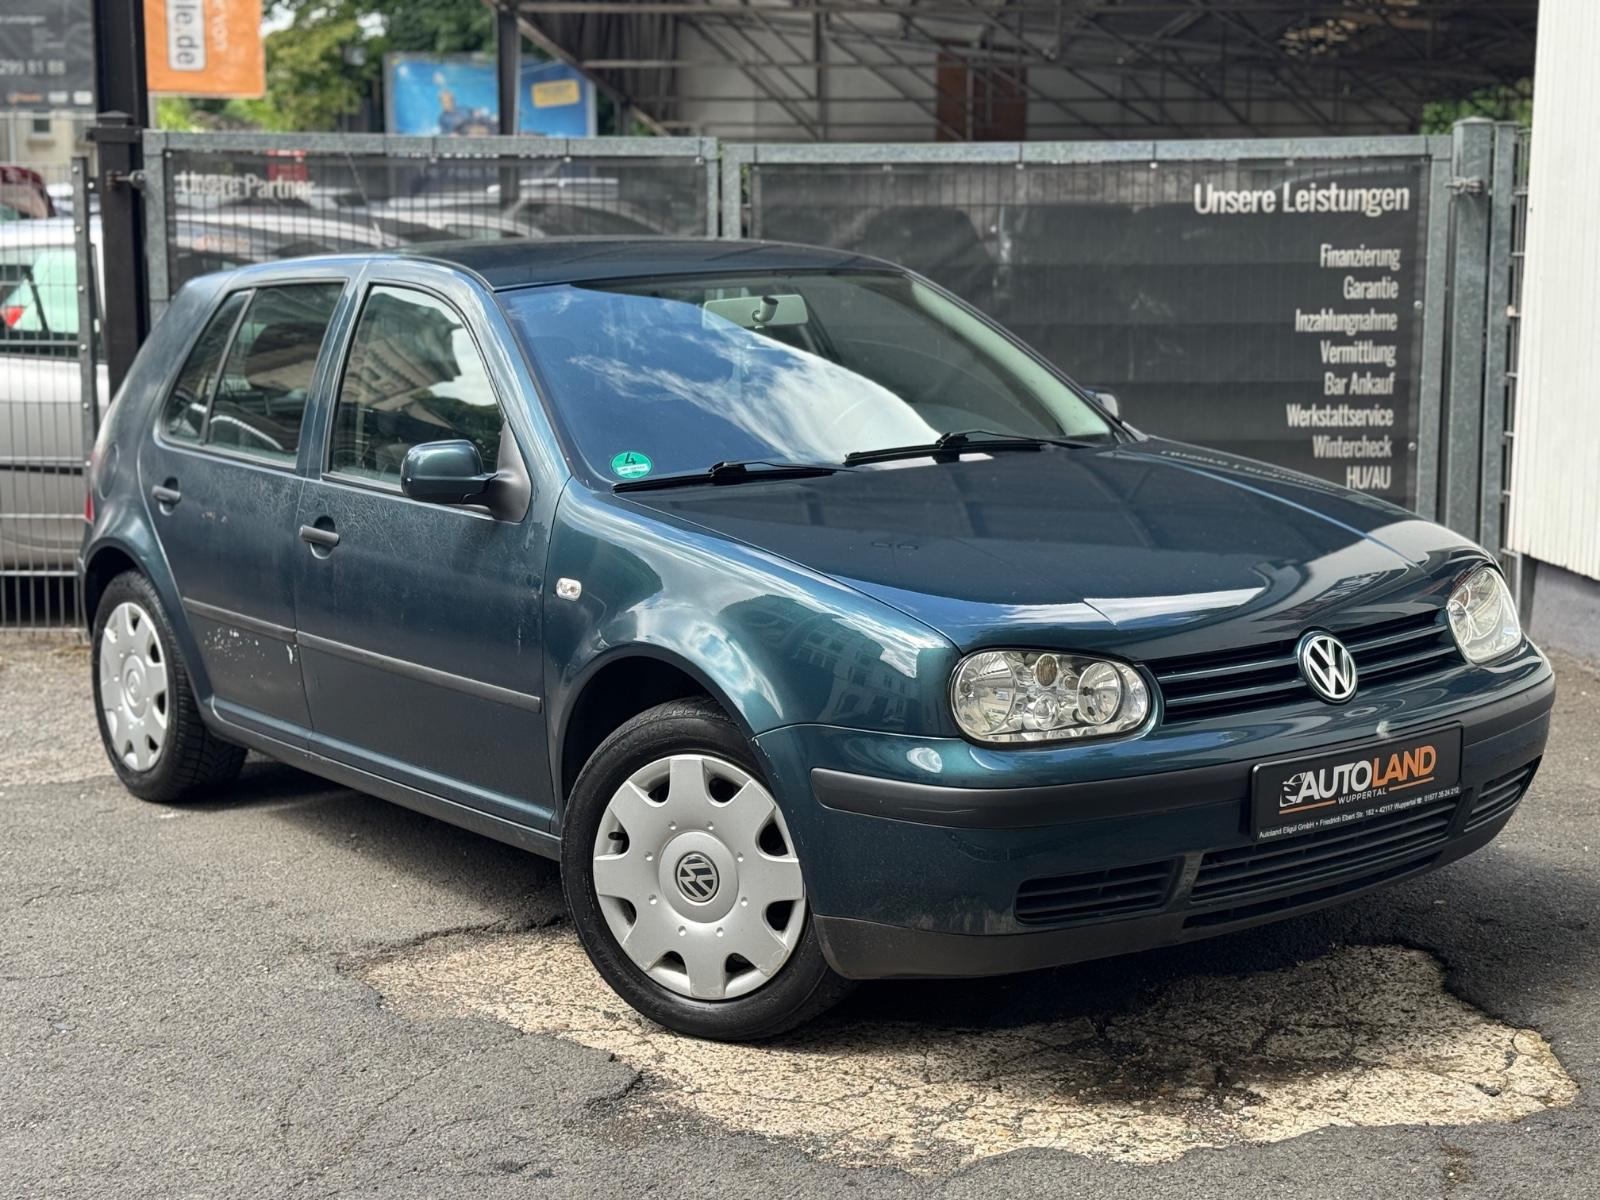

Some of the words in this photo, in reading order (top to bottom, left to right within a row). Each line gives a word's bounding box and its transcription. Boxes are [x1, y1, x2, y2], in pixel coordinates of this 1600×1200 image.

[243, 173, 315, 201] Partner
[1194, 183, 1276, 214] Unsere
[1283, 182, 1410, 217] Leistungen
[1320, 244, 1401, 271] Finanzierung
[1343, 276, 1399, 299] Garantie
[1295, 308, 1398, 335] Inzahlungnahme
[1320, 340, 1396, 367] Vermittlung
[1324, 373, 1347, 395] Bar
[1349, 372, 1395, 395] Ankauf
[1286, 403, 1394, 427] Werkstattservice
[625, 453, 637, 464] 4
[1313, 434, 1392, 458] Wintercheck
[1346, 466, 1391, 489] HU/AU
[1296, 745, 1437, 804] AUTOLAND
[1338, 788, 1387, 805] WUPPERTAL
[1298, 822, 1314, 831] GmbH
[1319, 815, 1341, 826] Friedrich
[1342, 812, 1356, 822] Ebert
[1379, 803, 1393, 813] 42117
[1394, 798, 1416, 810] Wuppertal
